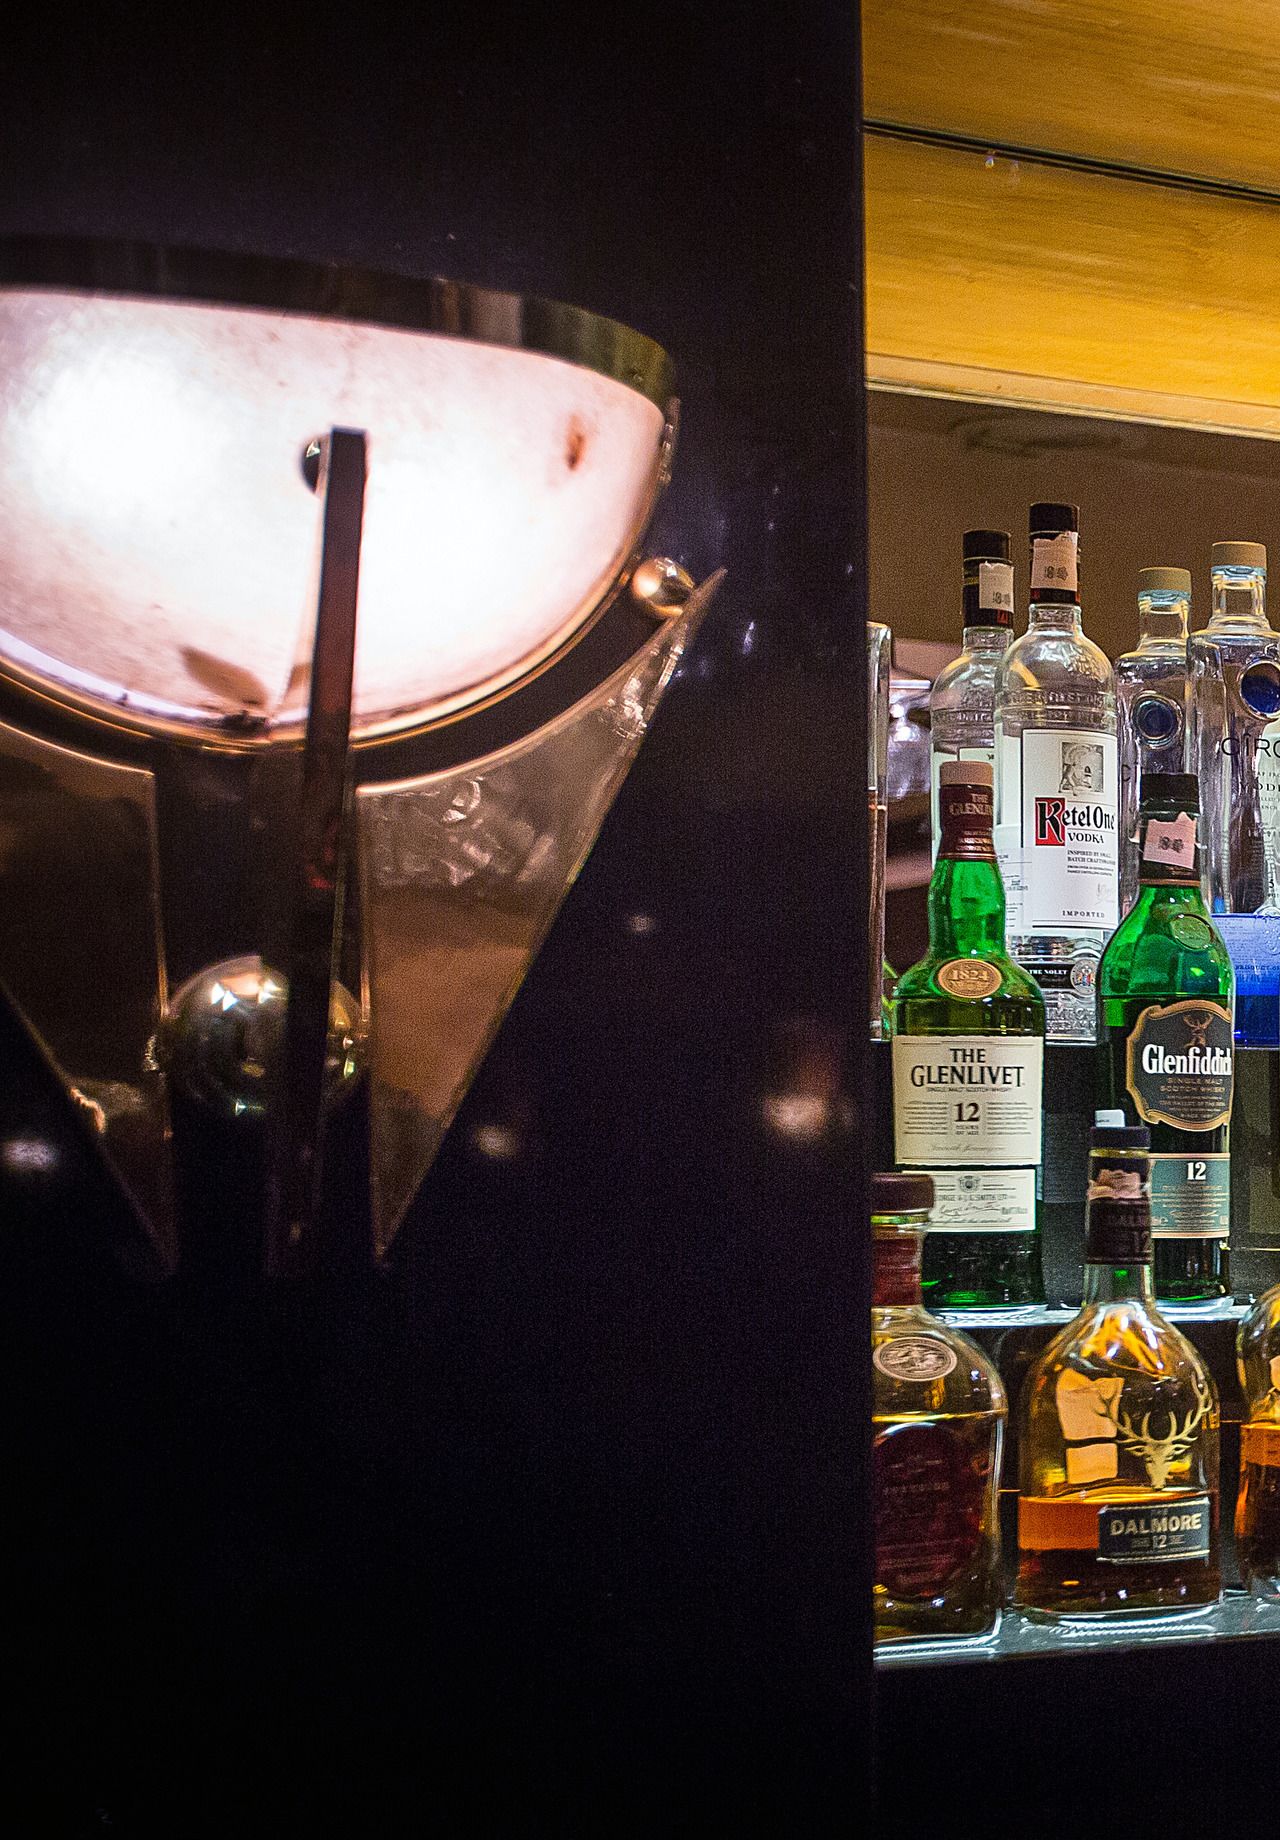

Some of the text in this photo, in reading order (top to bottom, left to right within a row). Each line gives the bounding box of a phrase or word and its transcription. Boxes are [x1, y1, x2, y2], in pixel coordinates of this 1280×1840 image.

[1036, 801, 1116, 843] Ketel One
[1067, 832, 1105, 844] VODKA
[1062, 909, 1105, 919] IMPORTED
[949, 1048, 986, 1064] THE
[910, 1064, 1024, 1088] GLENLIVET
[953, 1102, 981, 1122] 12
[1186, 1161, 1207, 1181] 12
[1109, 1512, 1202, 1536] DALMORE
